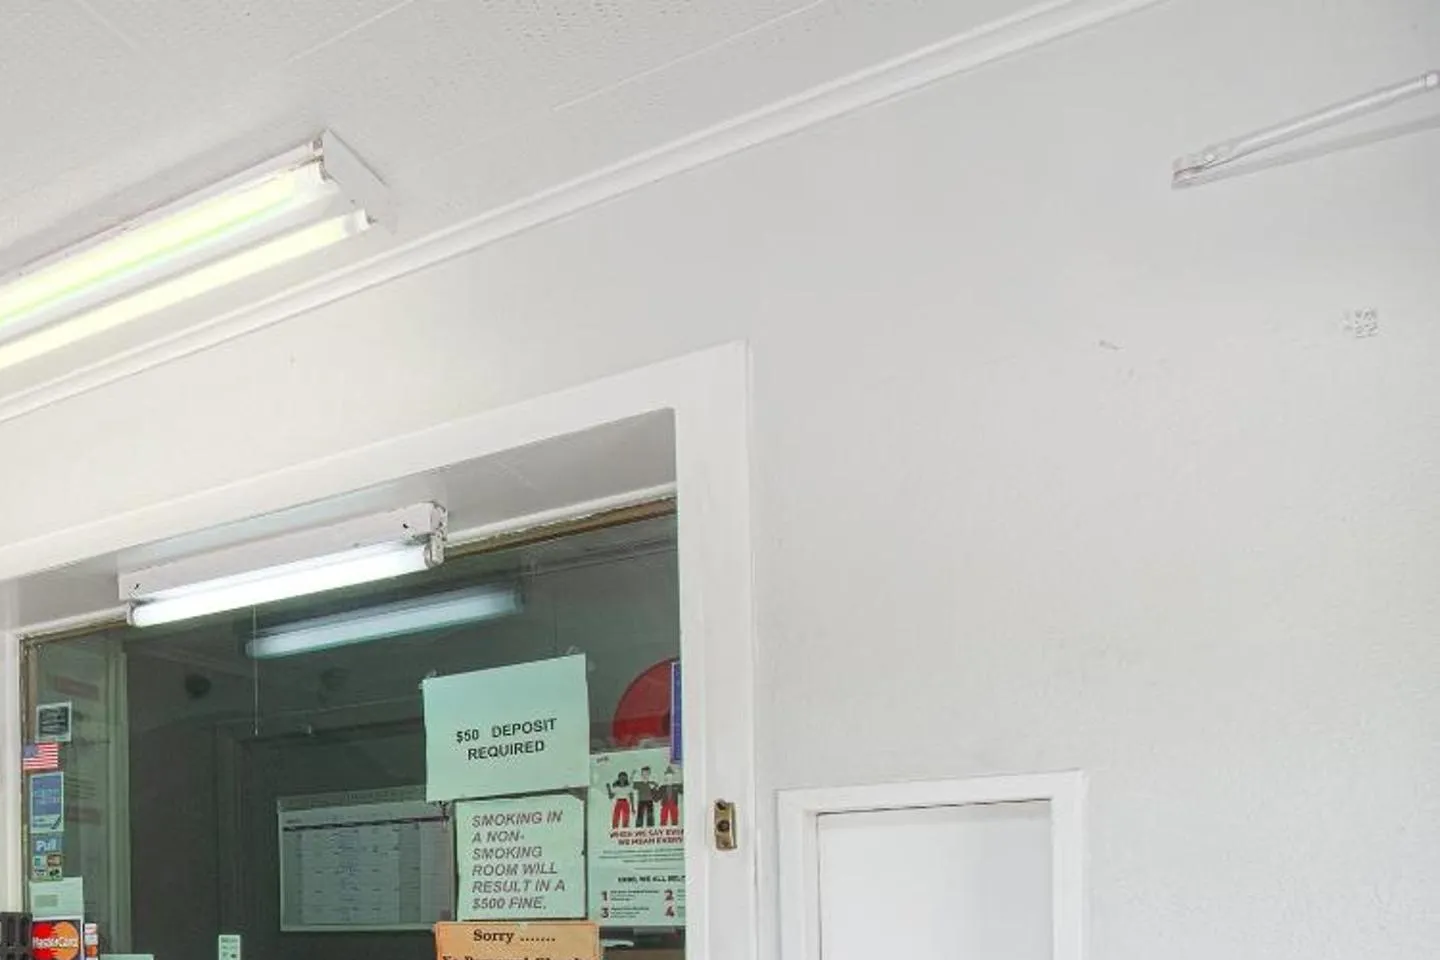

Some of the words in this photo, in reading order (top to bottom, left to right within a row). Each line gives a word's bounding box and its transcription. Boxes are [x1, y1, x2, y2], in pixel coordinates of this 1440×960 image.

[456, 728, 480, 744] $50
[491, 718, 557, 738] DEPOSIT
[467, 740, 545, 760] REQUIRED
[472, 811, 543, 828] SMOKING
[547, 810, 563, 824] IN
[472, 832, 481, 843] A
[486, 830, 525, 843] NON-
[472, 846, 543, 860] SMOKING
[472, 863, 519, 876] ROOM
[523, 862, 558, 875] WILL
[472, 880, 532, 893] RESULT
[536, 879, 550, 892] IN
[554, 879, 566, 892] A
[472, 897, 506, 911] $500
[509, 896, 547, 910] FINE.
[473, 929, 515, 944] Sorry
